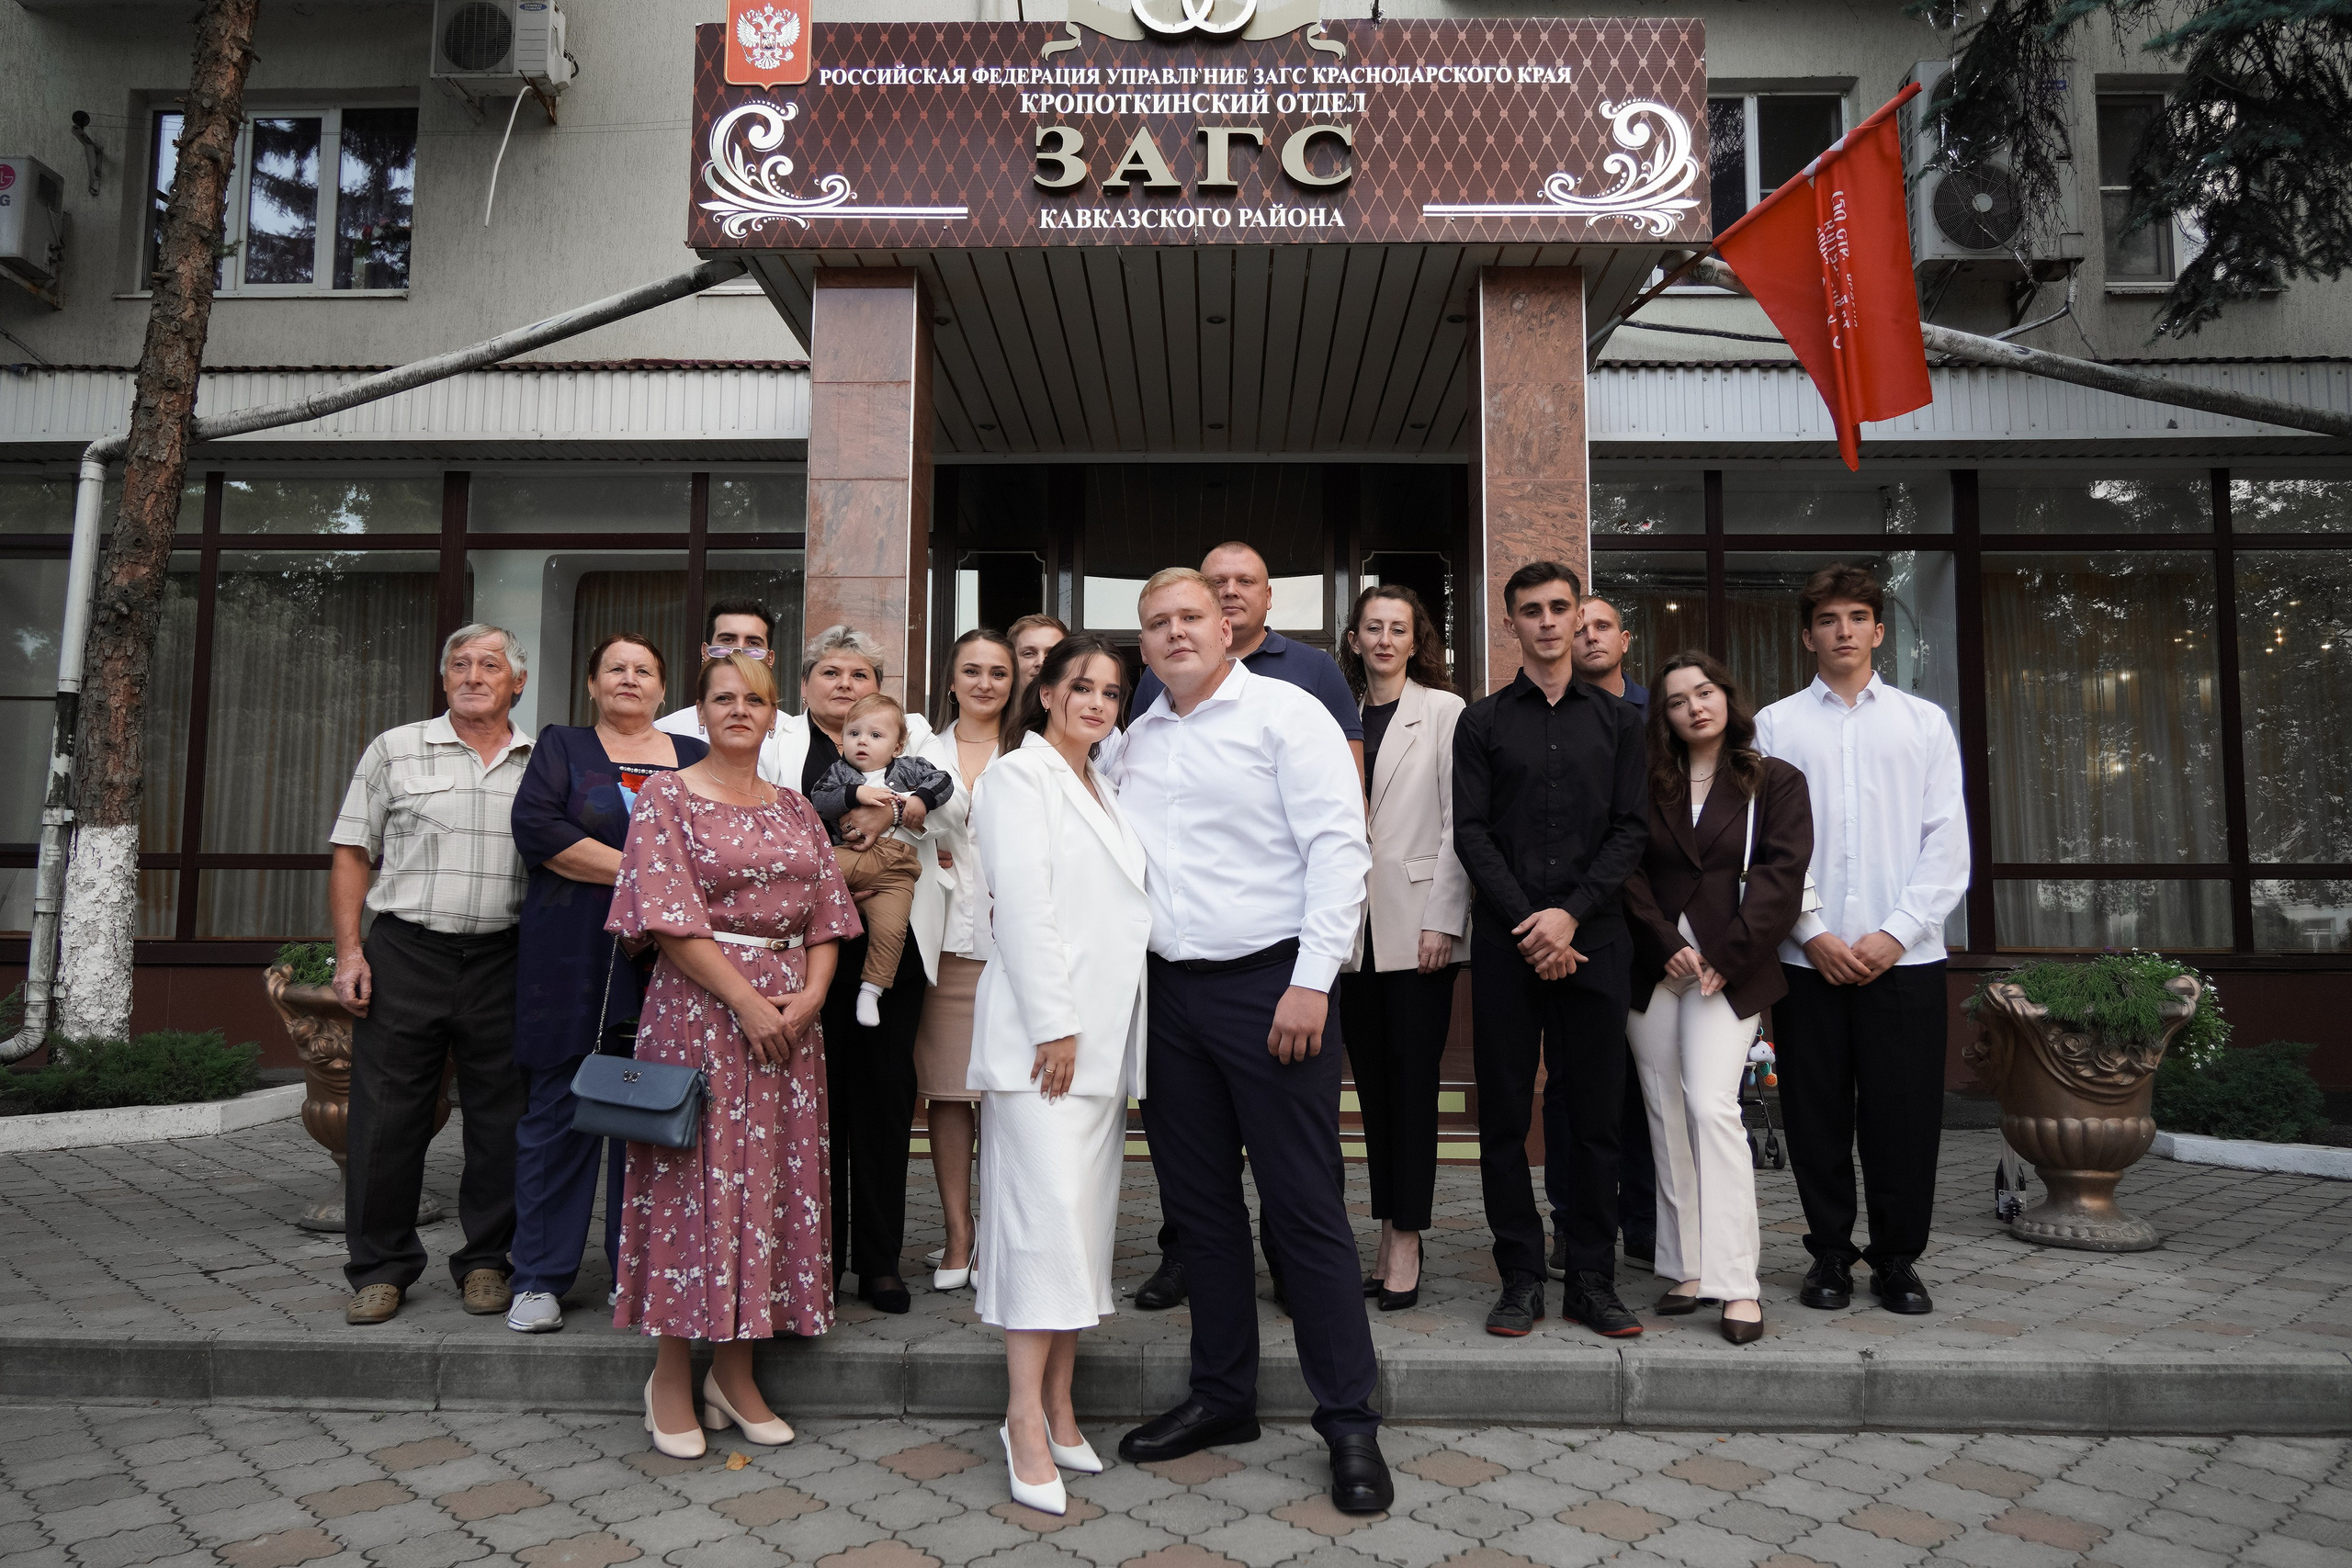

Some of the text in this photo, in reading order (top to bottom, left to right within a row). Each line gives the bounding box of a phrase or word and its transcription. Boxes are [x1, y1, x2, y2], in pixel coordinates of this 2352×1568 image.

[820, 64, 1571, 87] РОССИЙСКАЯ ФЕДЕРАЦИЯ УПРАВЛЕНИЕ ЗАГС КРАСНОДАРСКОГО КРАЯ
[1020, 88, 1367, 118] КРОПОТКИНСКИЙ ОТДЕЛ
[1033, 124, 1352, 191] ЗАГС
[1039, 204, 1346, 230] КАВКАЗСКОГО РАЙОНА
